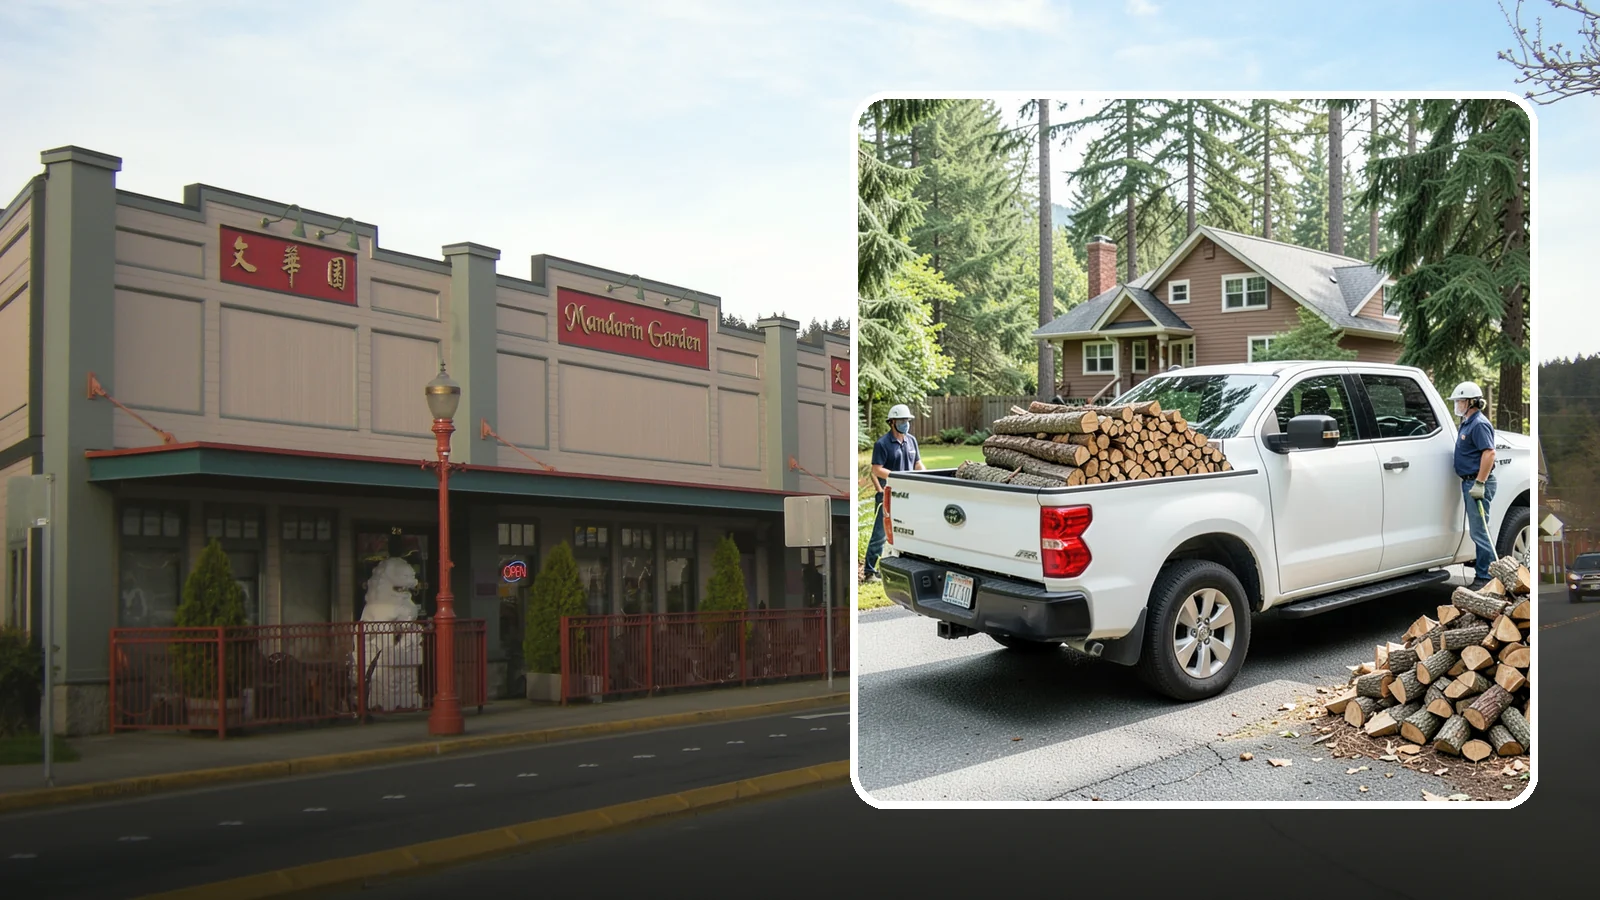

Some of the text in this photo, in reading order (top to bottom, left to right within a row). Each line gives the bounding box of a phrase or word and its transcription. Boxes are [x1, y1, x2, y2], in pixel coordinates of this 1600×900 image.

[230, 235, 346, 291] 文華園
[564, 302, 701, 352] Mandarin Garden
[503, 565, 527, 579] OPEN
